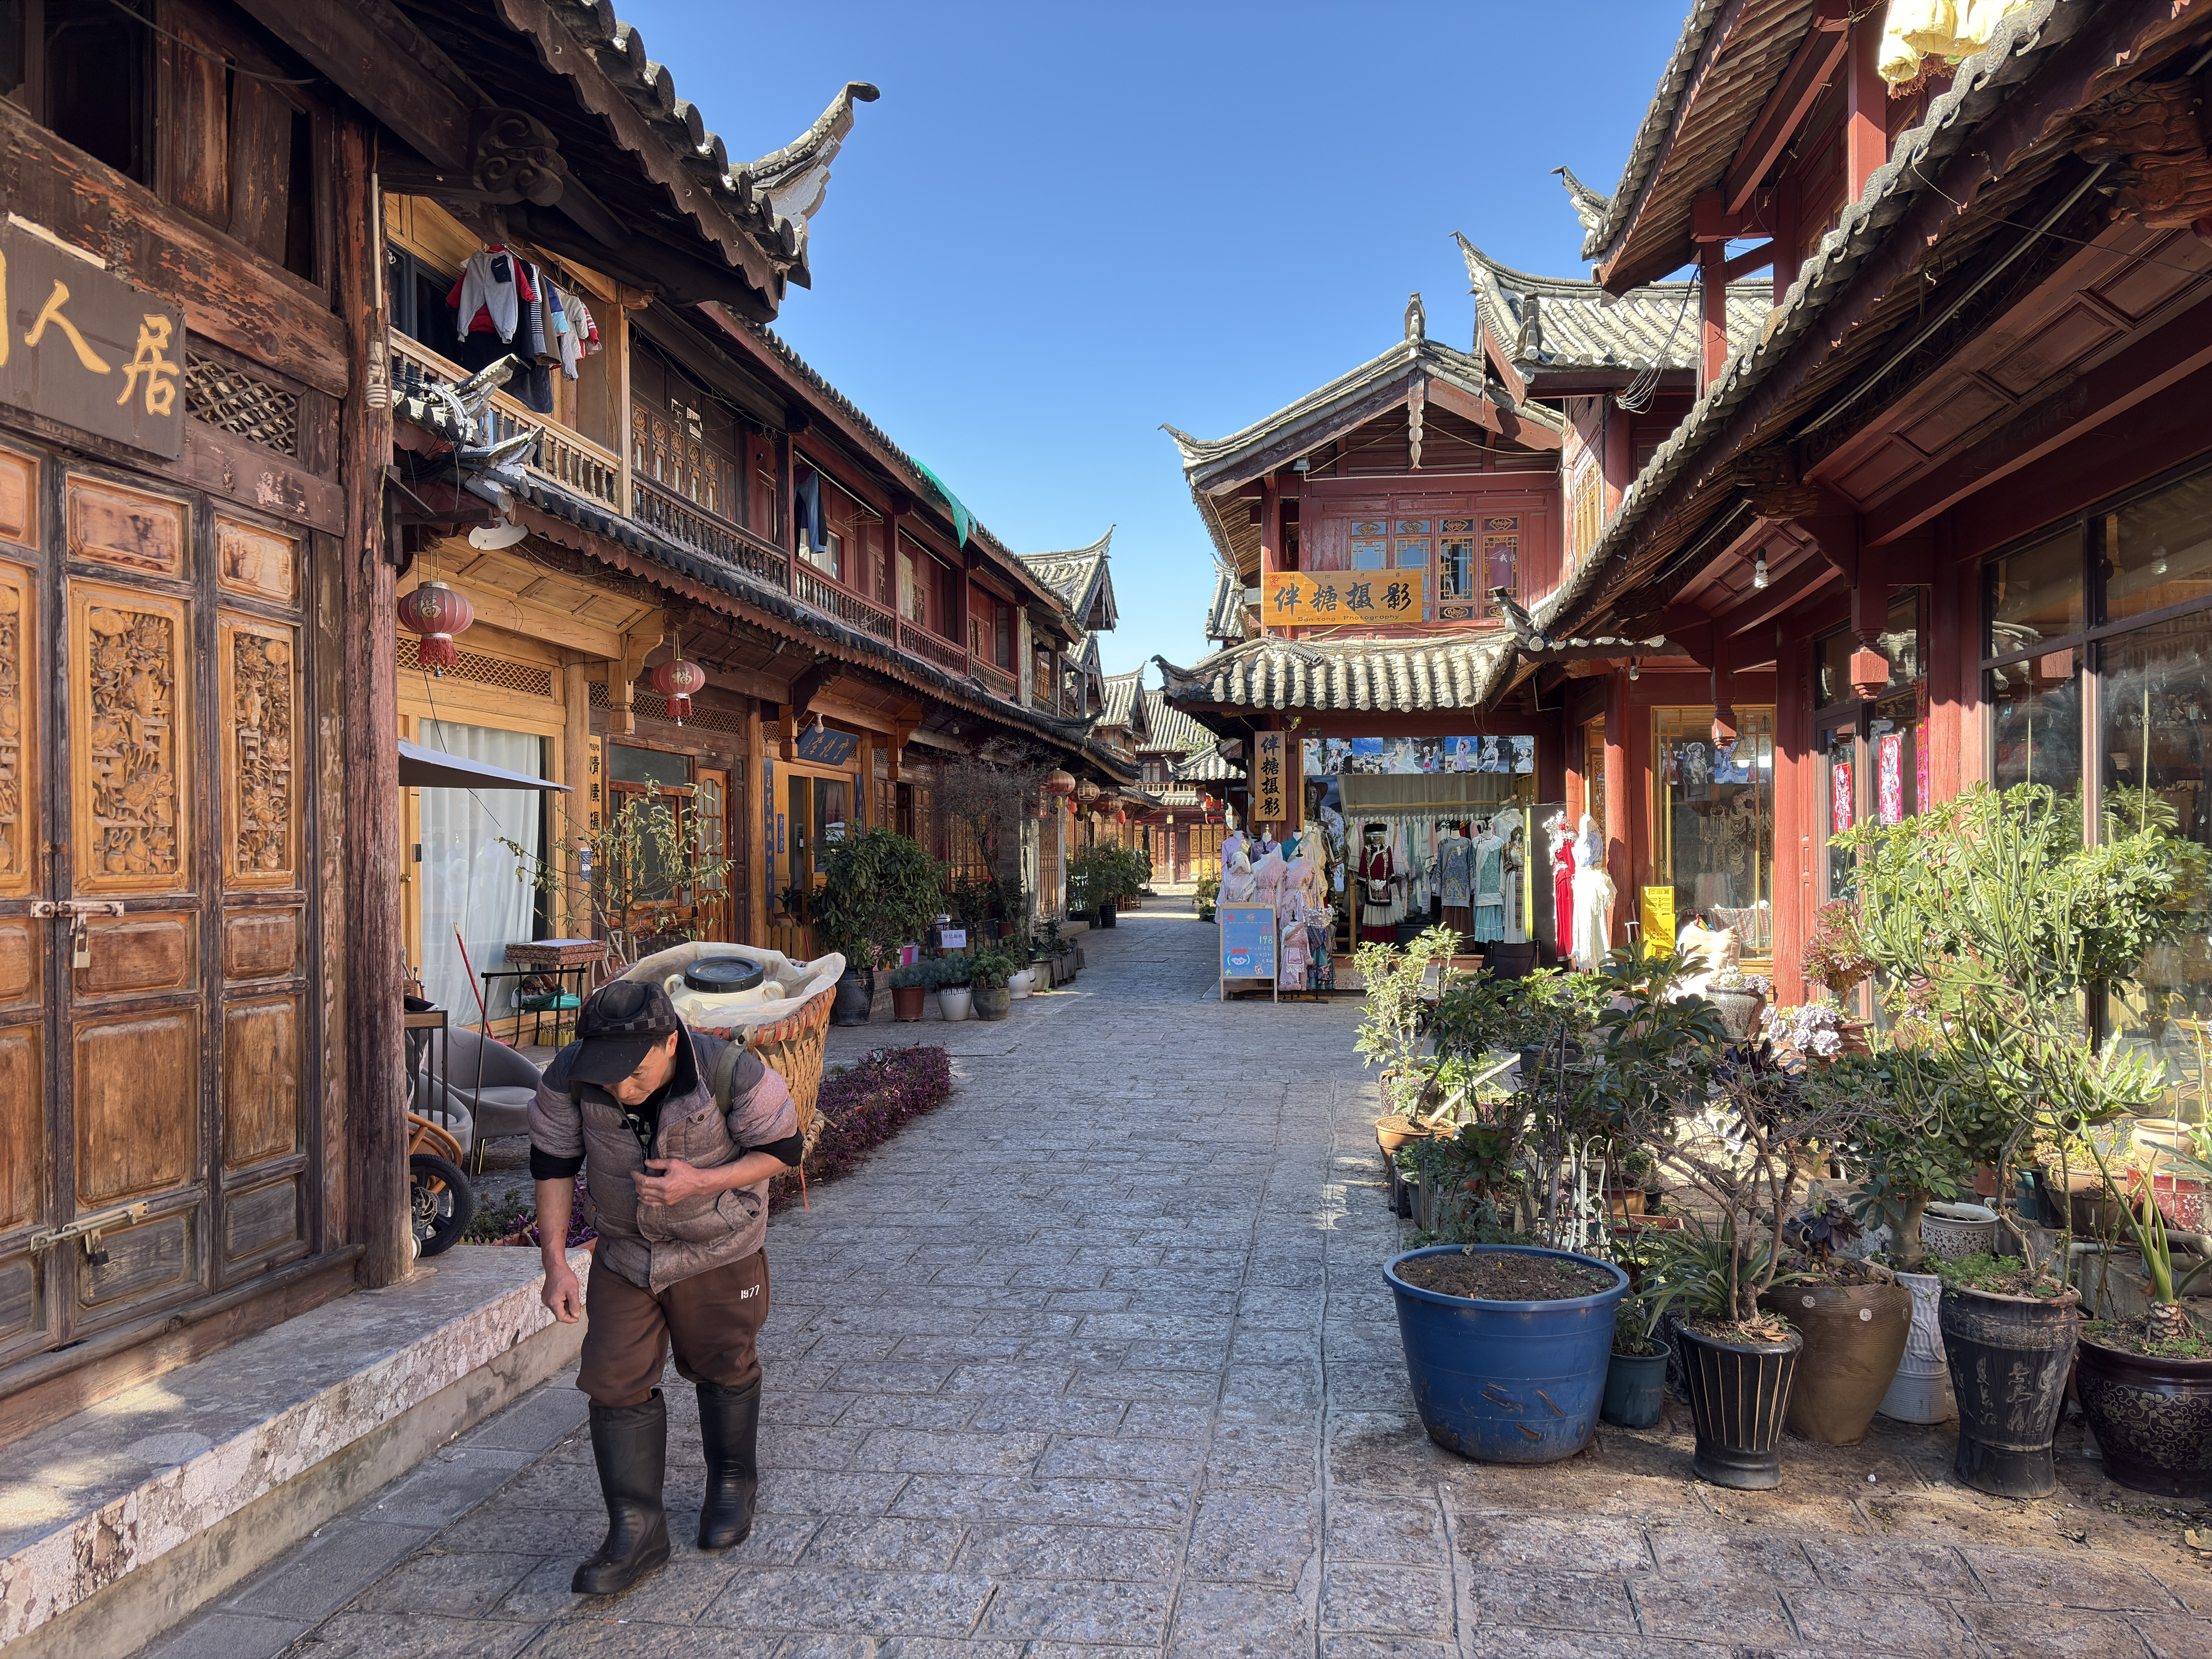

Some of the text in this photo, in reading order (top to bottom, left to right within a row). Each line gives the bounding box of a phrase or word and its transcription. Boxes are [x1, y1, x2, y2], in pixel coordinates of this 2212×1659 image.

[0, 243, 180, 416] 人居
[411, 594, 442, 619] 福
[1274, 582, 1412, 616] 伴糖摄影
[671, 667, 693, 685] 福
[1260, 734, 1280, 817] 伴糖摄影
[1259, 936, 1272, 944] 198
[740, 1284, 760, 1300] 1977
